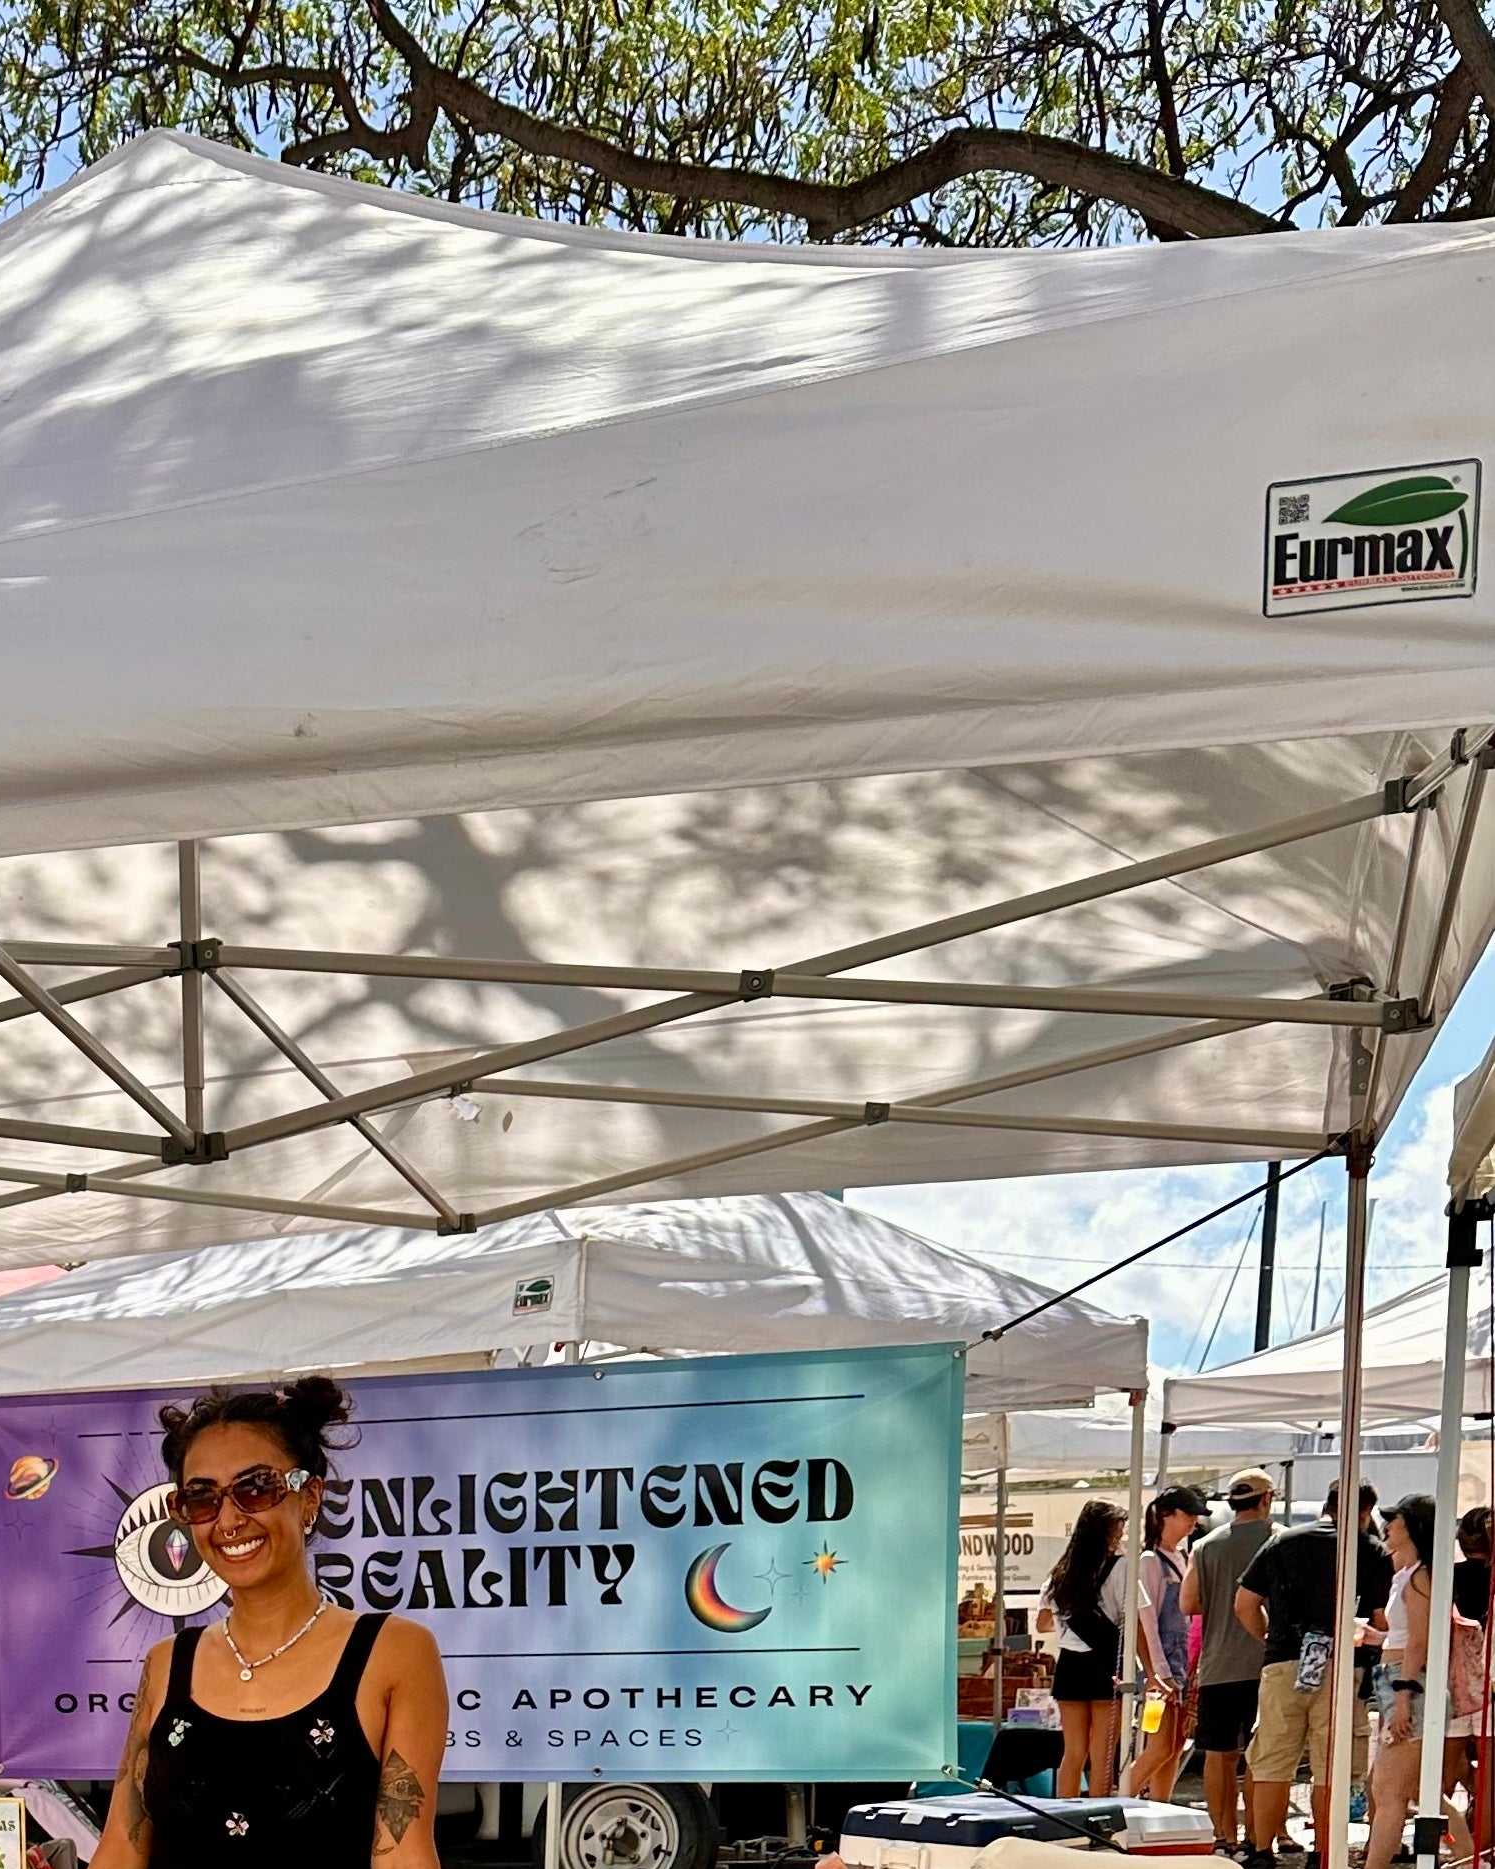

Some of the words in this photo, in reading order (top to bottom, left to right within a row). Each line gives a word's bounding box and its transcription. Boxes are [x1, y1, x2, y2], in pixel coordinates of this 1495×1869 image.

[1274, 526, 1454, 586] Eurmax
[317, 1459, 854, 1540] ENLIGHTENED
[313, 1544, 635, 1610] REALITY
[511, 1685, 873, 1711] APOTHECARY
[505, 1730, 523, 1748] &
[547, 1728, 703, 1748] SPACES
